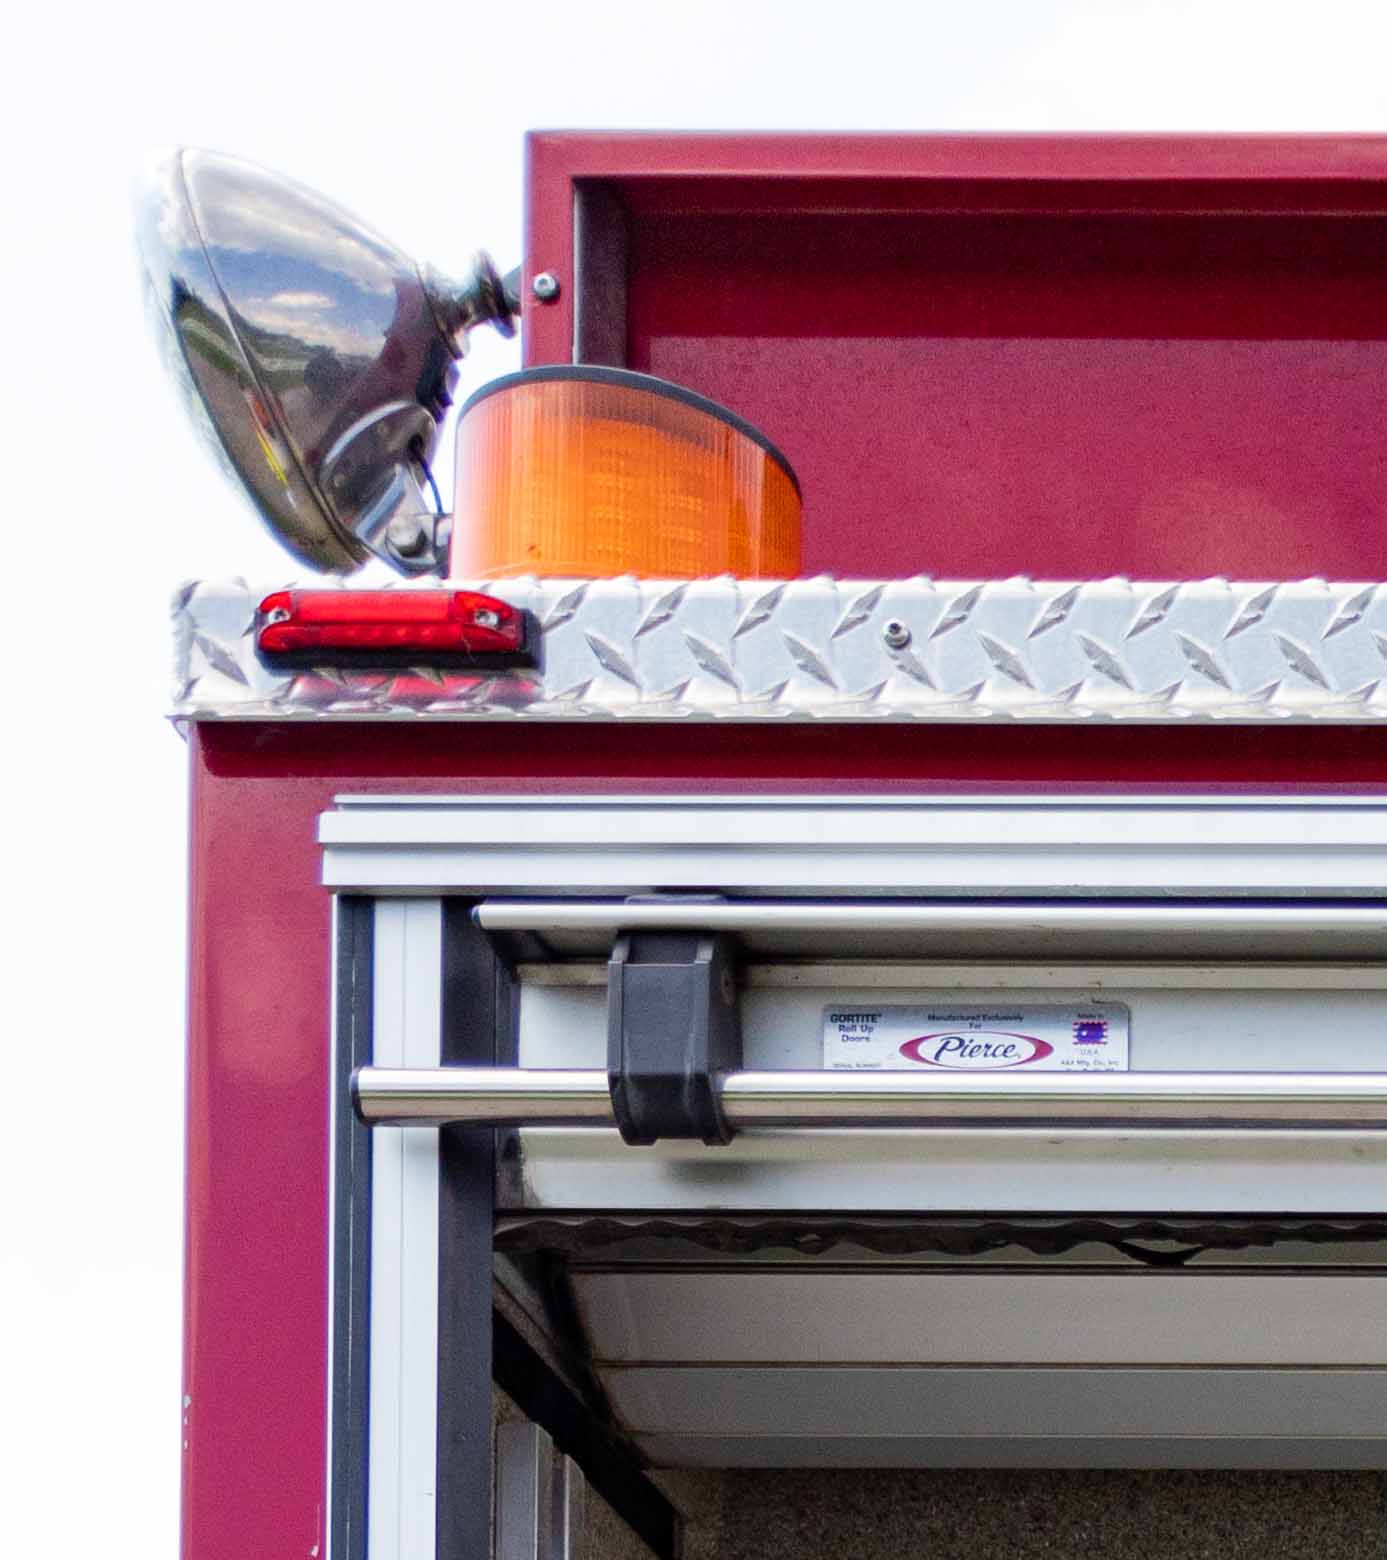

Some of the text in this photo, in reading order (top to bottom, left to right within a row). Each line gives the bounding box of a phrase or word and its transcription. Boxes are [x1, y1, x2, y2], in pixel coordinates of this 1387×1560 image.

[838, 1025, 874, 1035] Roll Up
[841, 1034, 871, 1043] Doors
[933, 1035, 1018, 1062] Pierce
